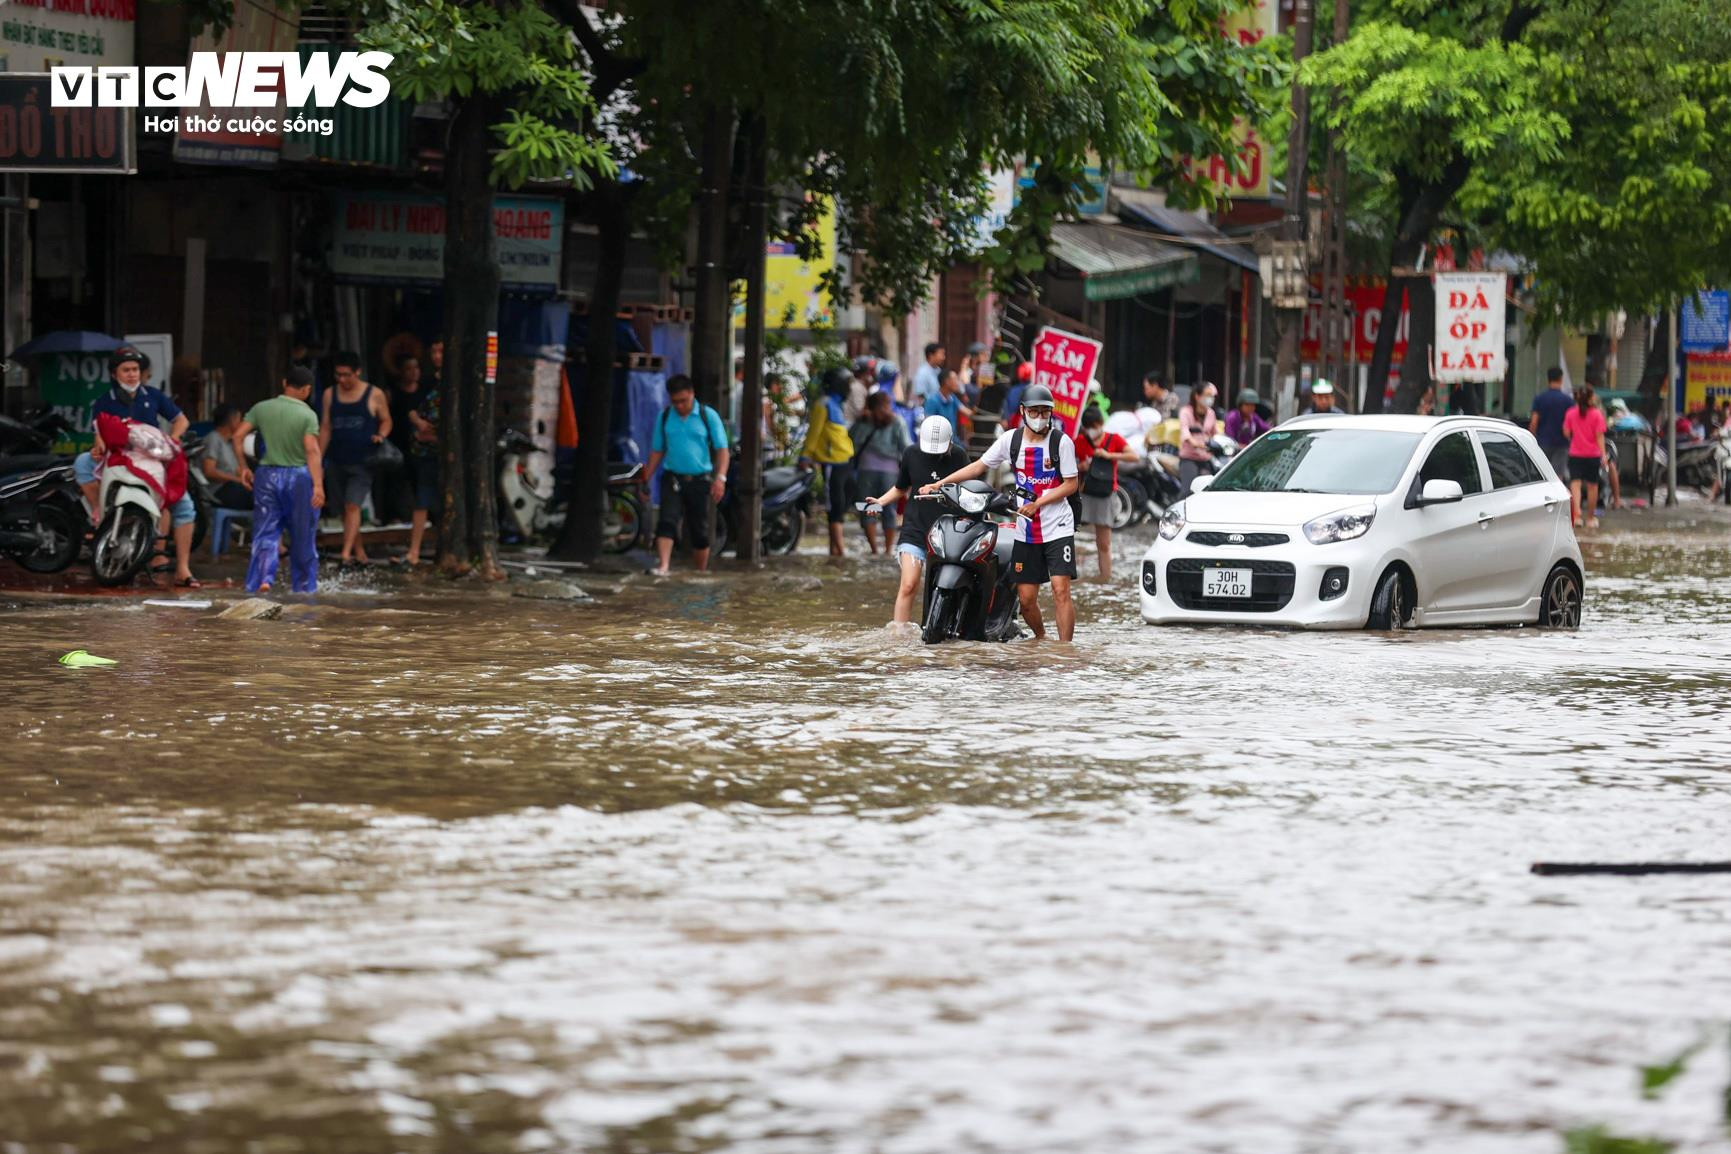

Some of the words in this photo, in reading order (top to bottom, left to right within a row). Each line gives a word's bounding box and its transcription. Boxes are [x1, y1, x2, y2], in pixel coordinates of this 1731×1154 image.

[1027, 475, 1053, 487] Spotify
[1228, 534, 1244, 543] KIA
[1063, 545, 1072, 562] 8
[1216, 571, 1238, 583] 30H
[1208, 583, 1246, 596] 574.02
